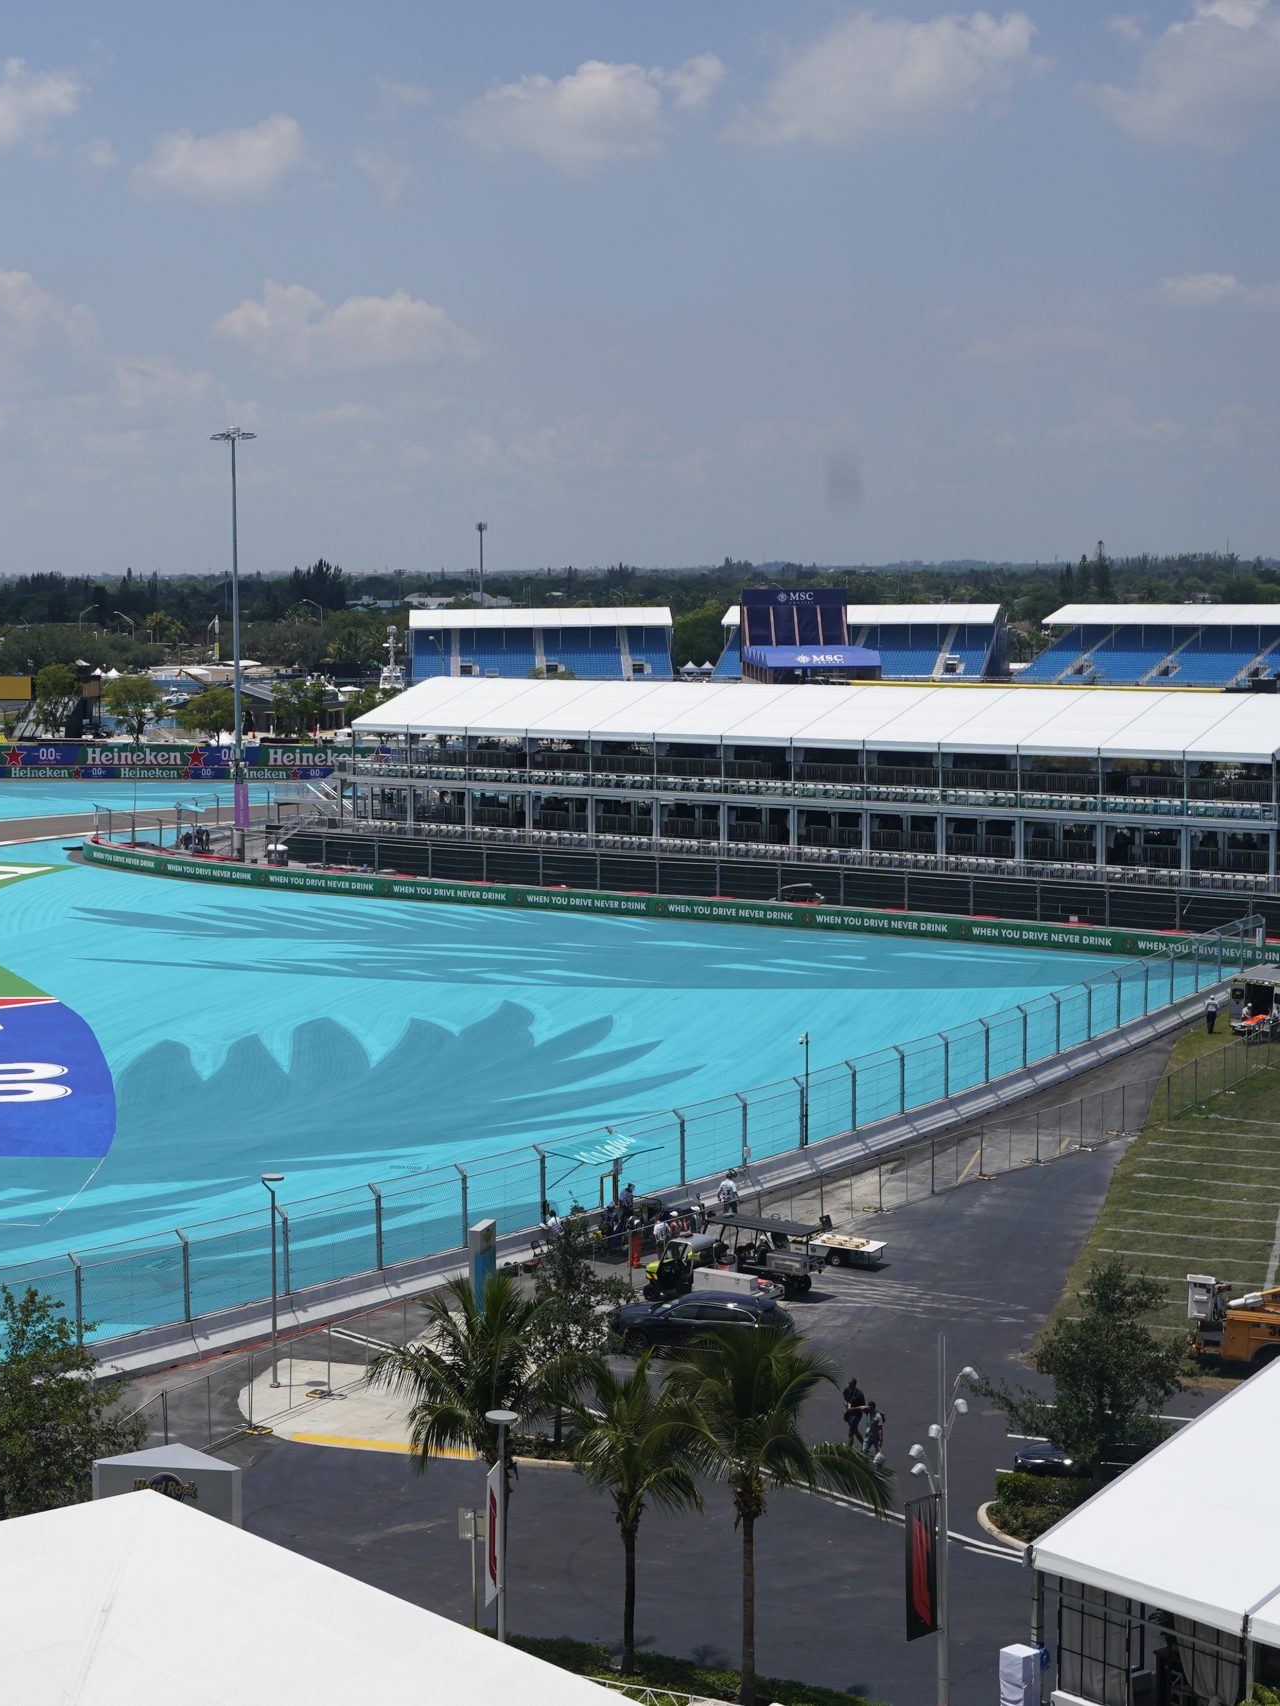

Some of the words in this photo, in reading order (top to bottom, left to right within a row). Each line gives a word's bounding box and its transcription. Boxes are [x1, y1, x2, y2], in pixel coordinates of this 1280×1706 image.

[789, 592, 814, 601] MSC
[86, 747, 182, 765] Heineken
[11, 767, 68, 778] Heineken
[121, 768, 178, 778] Heineken
[230, 768, 287, 779] Hineken
[167, 864, 183, 873] WHEN
[183, 866, 194, 874] YOU
[195, 868, 212, 876] DRIVE
[212, 869, 231, 878] NEVER
[232, 871, 252, 880] DRINK
[269, 874, 289, 884] WHEN
[290, 876, 305, 885] YOU
[306, 877, 326, 887] DRIVE
[327, 879, 350, 889] NEVER
[351, 881, 374, 891] DRINK
[393, 885, 415, 894] WHEN
[416, 886, 432, 895] YOU
[434, 888, 455, 897] DRIVE
[456, 890, 480, 899] NEVER
[482, 891, 506, 901] DRINK
[526, 894, 550, 904] WHEN
[551, 896, 568, 905] YOU
[570, 897, 592, 907] DRIVE
[594, 899, 619, 909] NEVER
[621, 901, 646, 911] DRINK
[668, 904, 692, 914] WHEN
[693, 905, 711, 915] YOU
[712, 907, 736, 917] DRIVE
[738, 909, 764, 919] NEVER
[766, 910, 793, 921] DRINK
[815, 914, 841, 924] WHEN
[843, 916, 862, 926] YOU
[863, 918, 889, 928] DRIVE
[891, 920, 918, 930] NEVER
[920, 922, 948, 932] DRINK
[972, 926, 999, 936] WHEN
[1001, 928, 1020, 938] YOU
[1022, 931, 1048, 941] DRIVE
[1051, 933, 1080, 943] NEVER
[1083, 935, 1112, 946] DRINK
[1137, 940, 1166, 950] WHEN
[1168, 943, 1189, 953] YOU
[1256, 951, 1280, 961] DRIN
[167, 1481, 198, 1499] Rock
